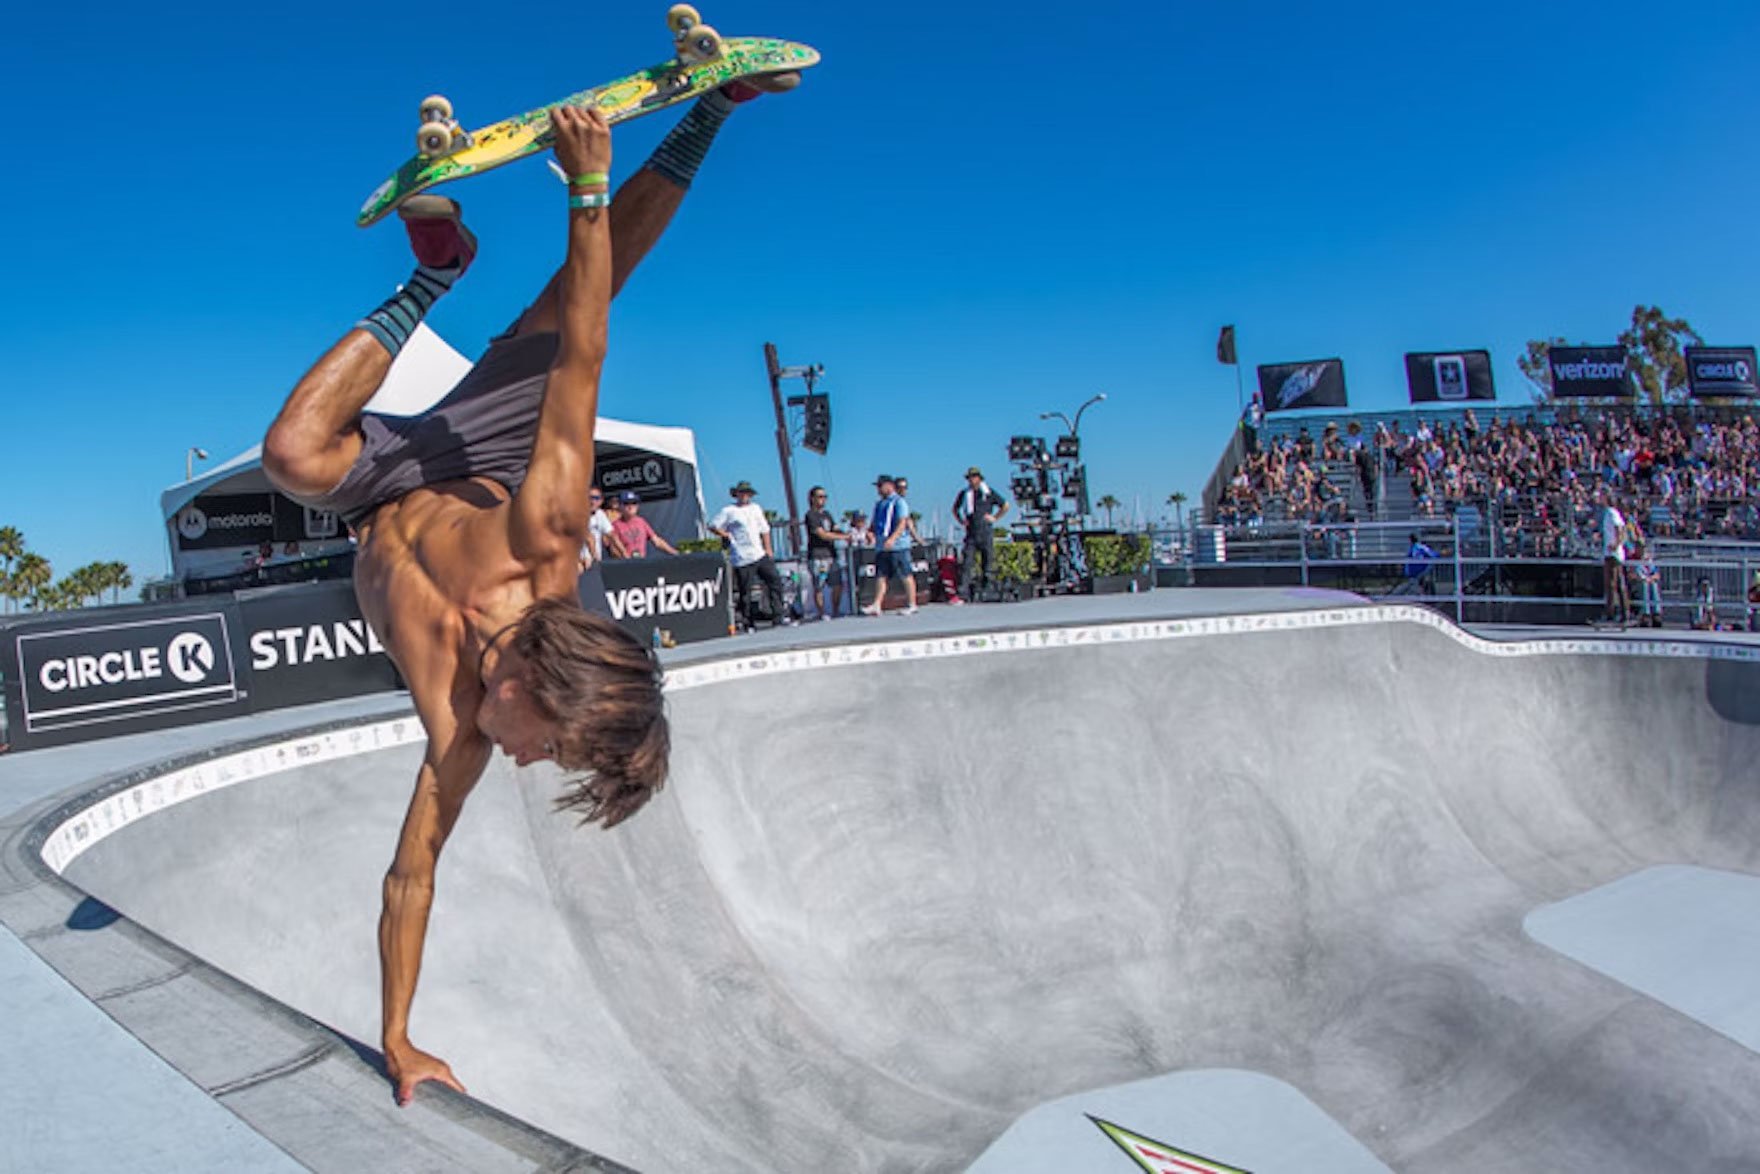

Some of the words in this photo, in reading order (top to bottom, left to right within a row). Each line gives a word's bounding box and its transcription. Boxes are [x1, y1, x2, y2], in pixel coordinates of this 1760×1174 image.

[1553, 359, 1623, 380] verizon
[602, 466, 642, 486] CIRCLE
[644, 461, 662, 482] K
[208, 512, 273, 529] motorola
[605, 577, 716, 619] verizon
[39, 647, 162, 692] CIRCLE
[171, 635, 213, 680] K
